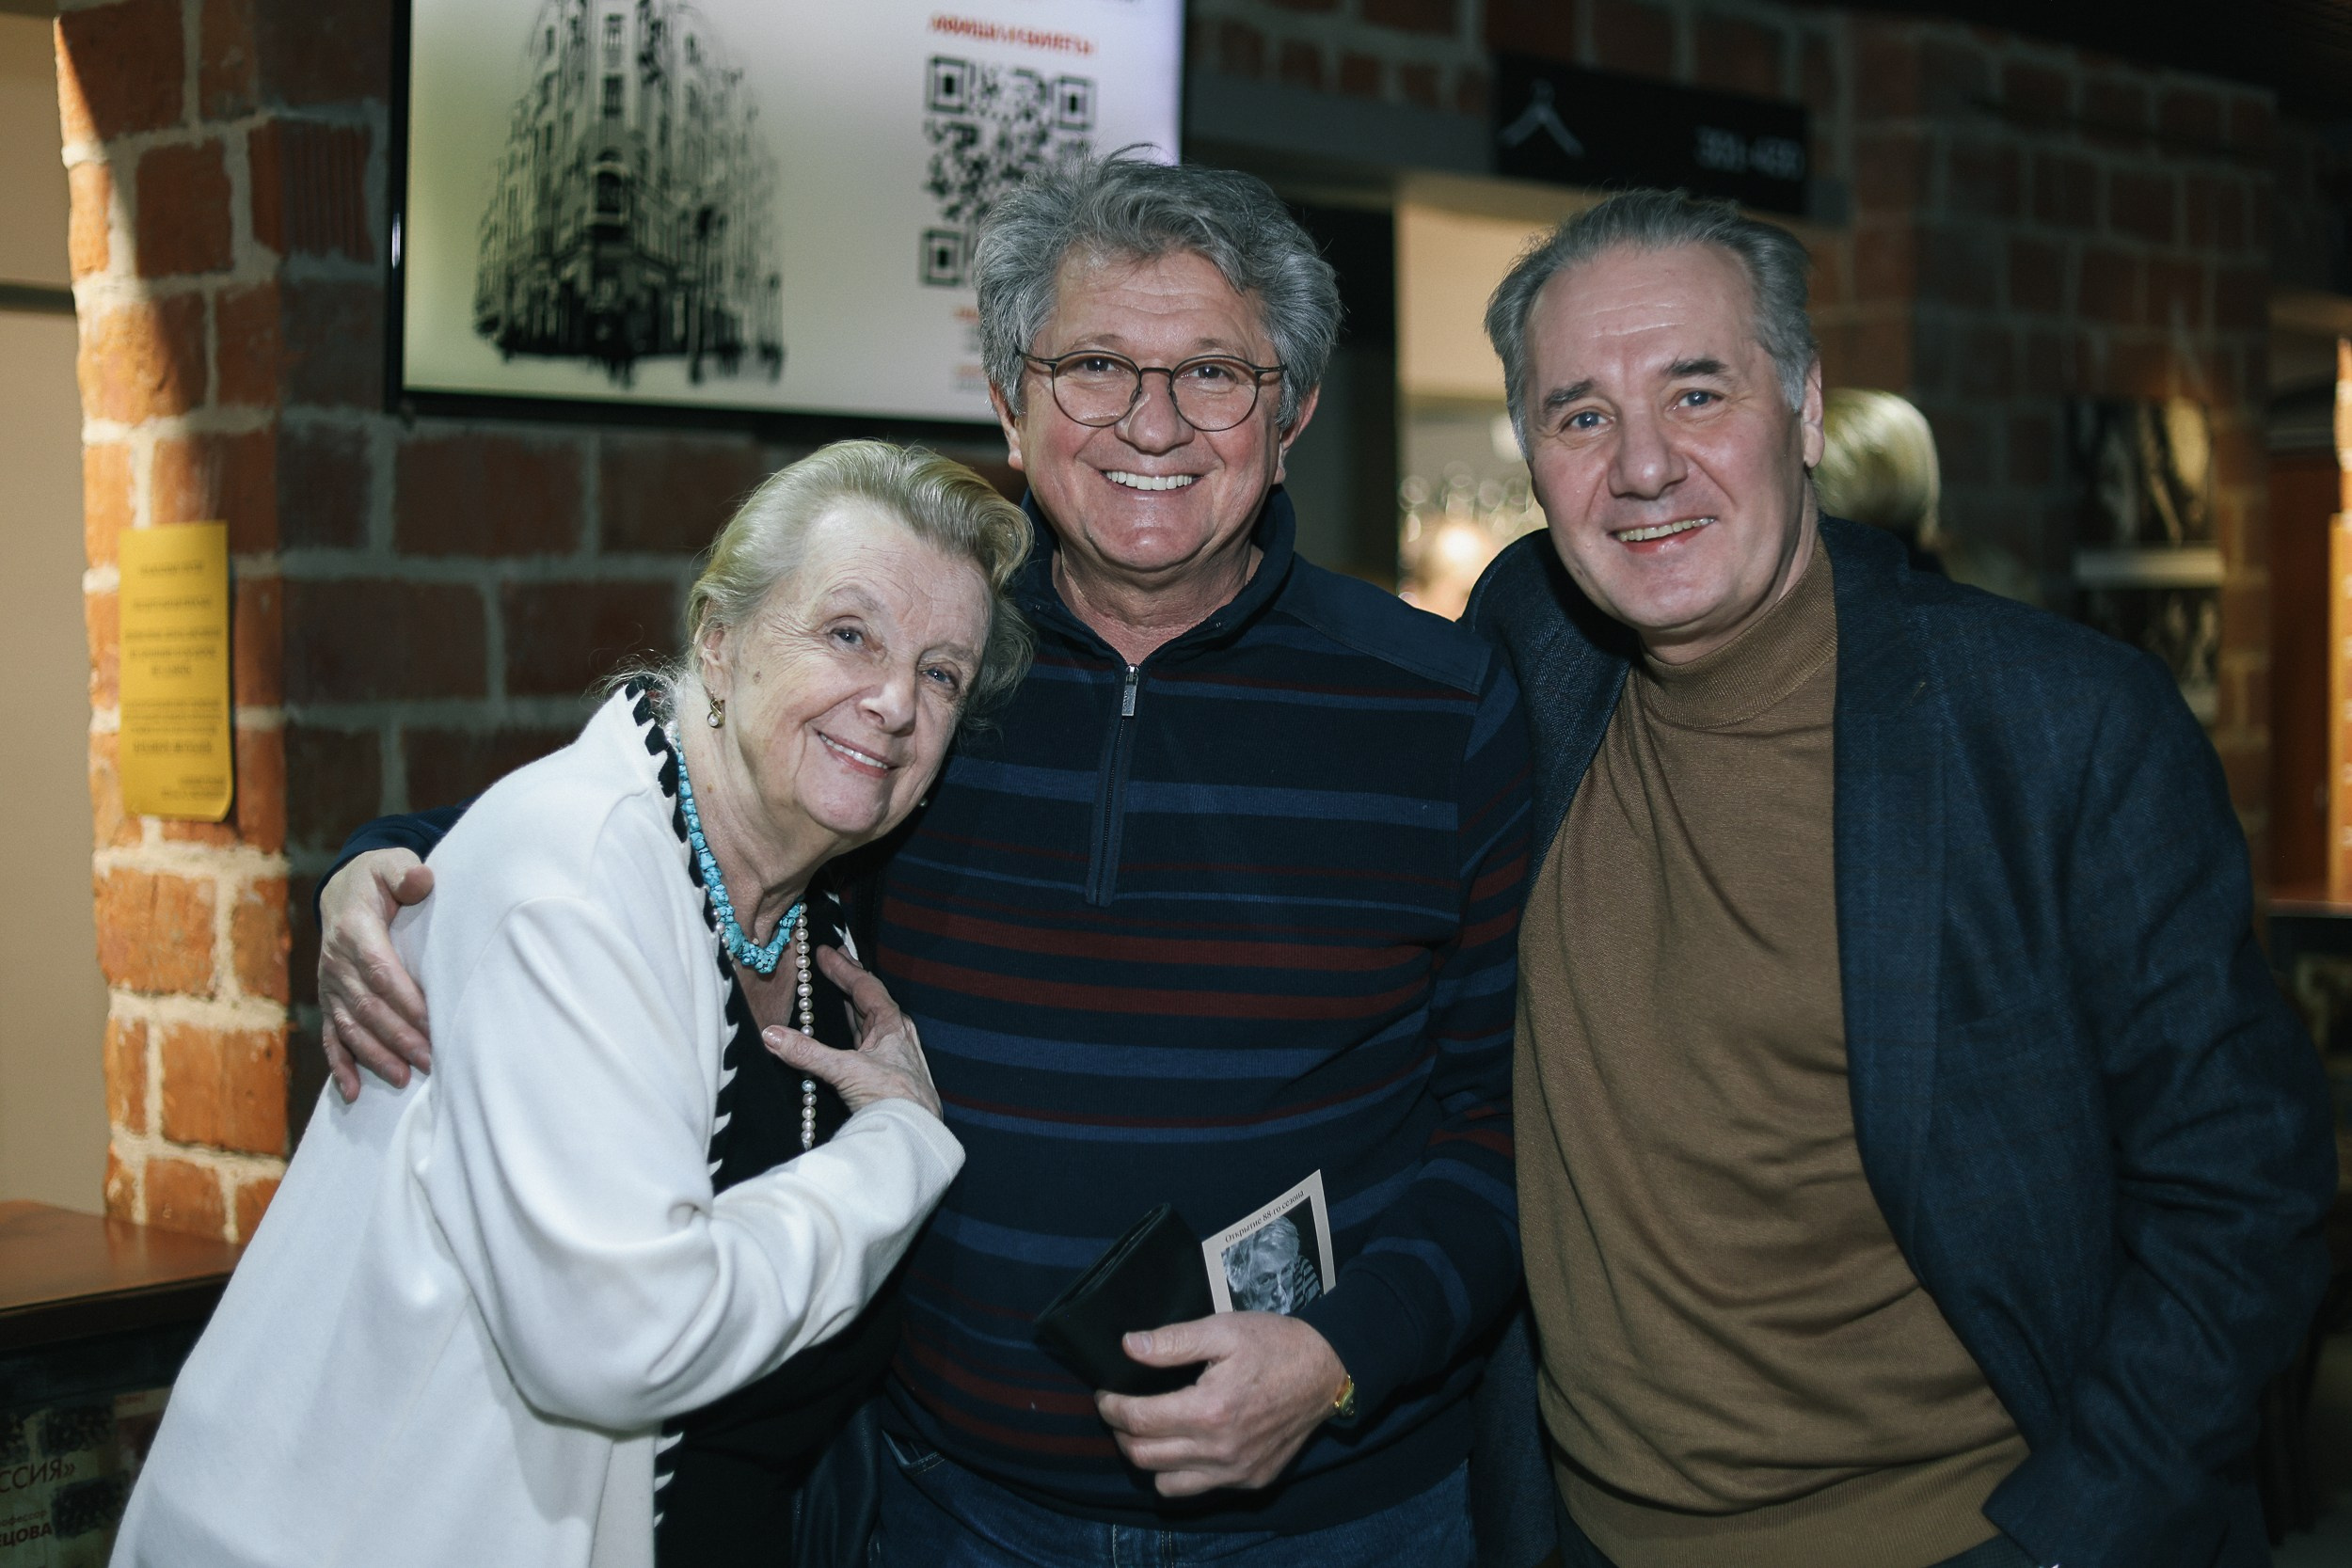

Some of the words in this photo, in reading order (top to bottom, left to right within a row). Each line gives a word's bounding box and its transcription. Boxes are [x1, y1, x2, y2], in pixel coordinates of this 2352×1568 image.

[1225, 1217, 1262, 1243] Открытие
[1281, 1190, 1304, 1210] сезона
[0, 1458, 76, 1493] ССИЯ»
[0, 1510, 47, 1527] офессор
[0, 1522, 54, 1547] ЦОВА
